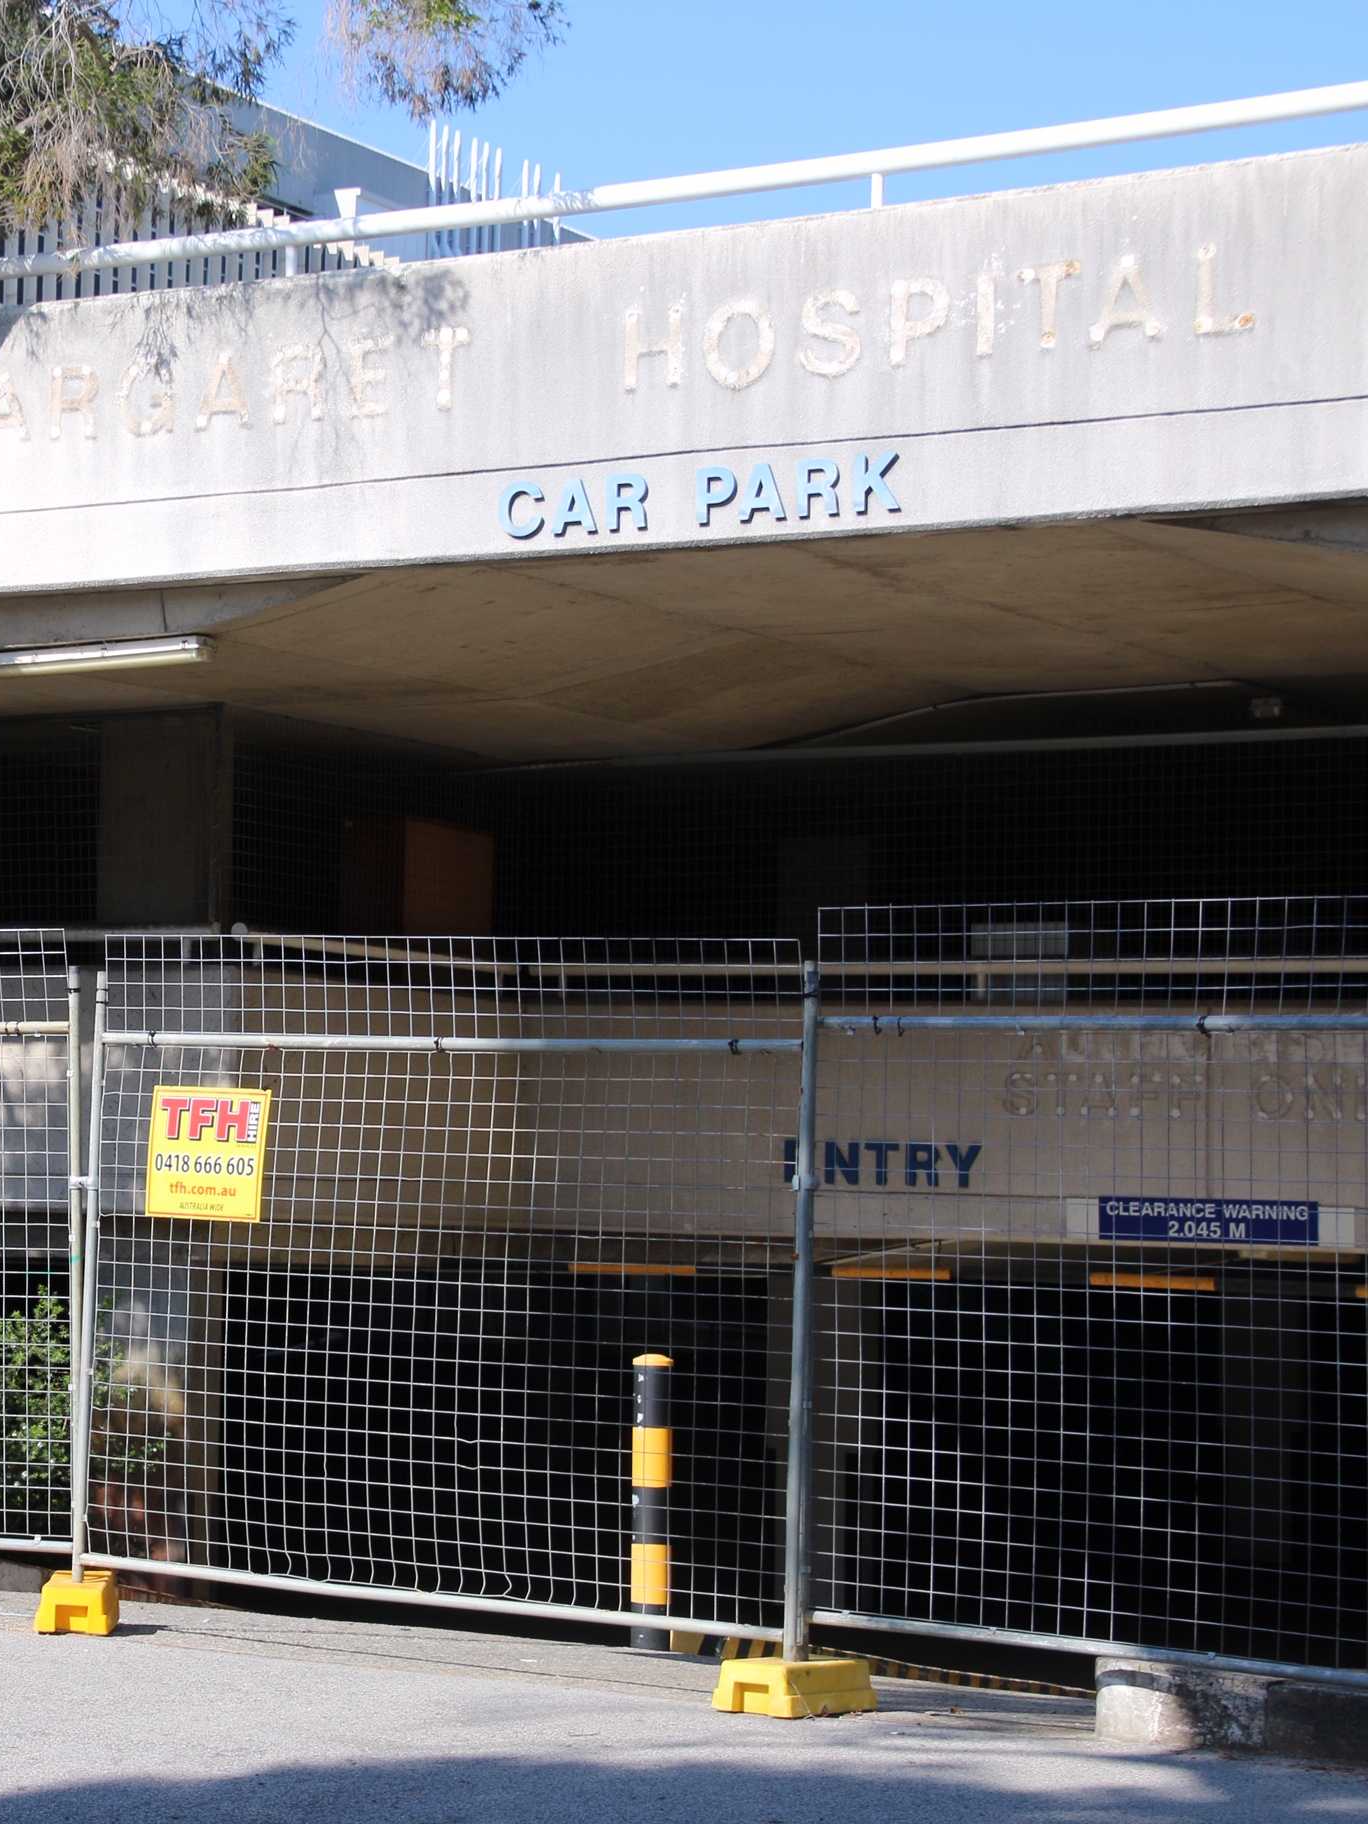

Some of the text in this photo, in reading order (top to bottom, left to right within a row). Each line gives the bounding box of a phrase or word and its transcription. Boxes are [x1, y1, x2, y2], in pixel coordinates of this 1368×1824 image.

[623, 242, 1256, 391] HOSPITAL
[498, 450, 902, 537] CAR PARK
[1003, 1071, 1204, 1119] STAFF
[161, 1097, 249, 1142] TFH
[246, 1101, 261, 1143] HIRE
[155, 1153, 255, 1176] 0418 666 605
[169, 1181, 237, 1197] tfh.com.au
[1106, 1201, 1309, 1220] CLEARANCE WARNING
[1168, 1221, 1245, 1239] 2.045 M
